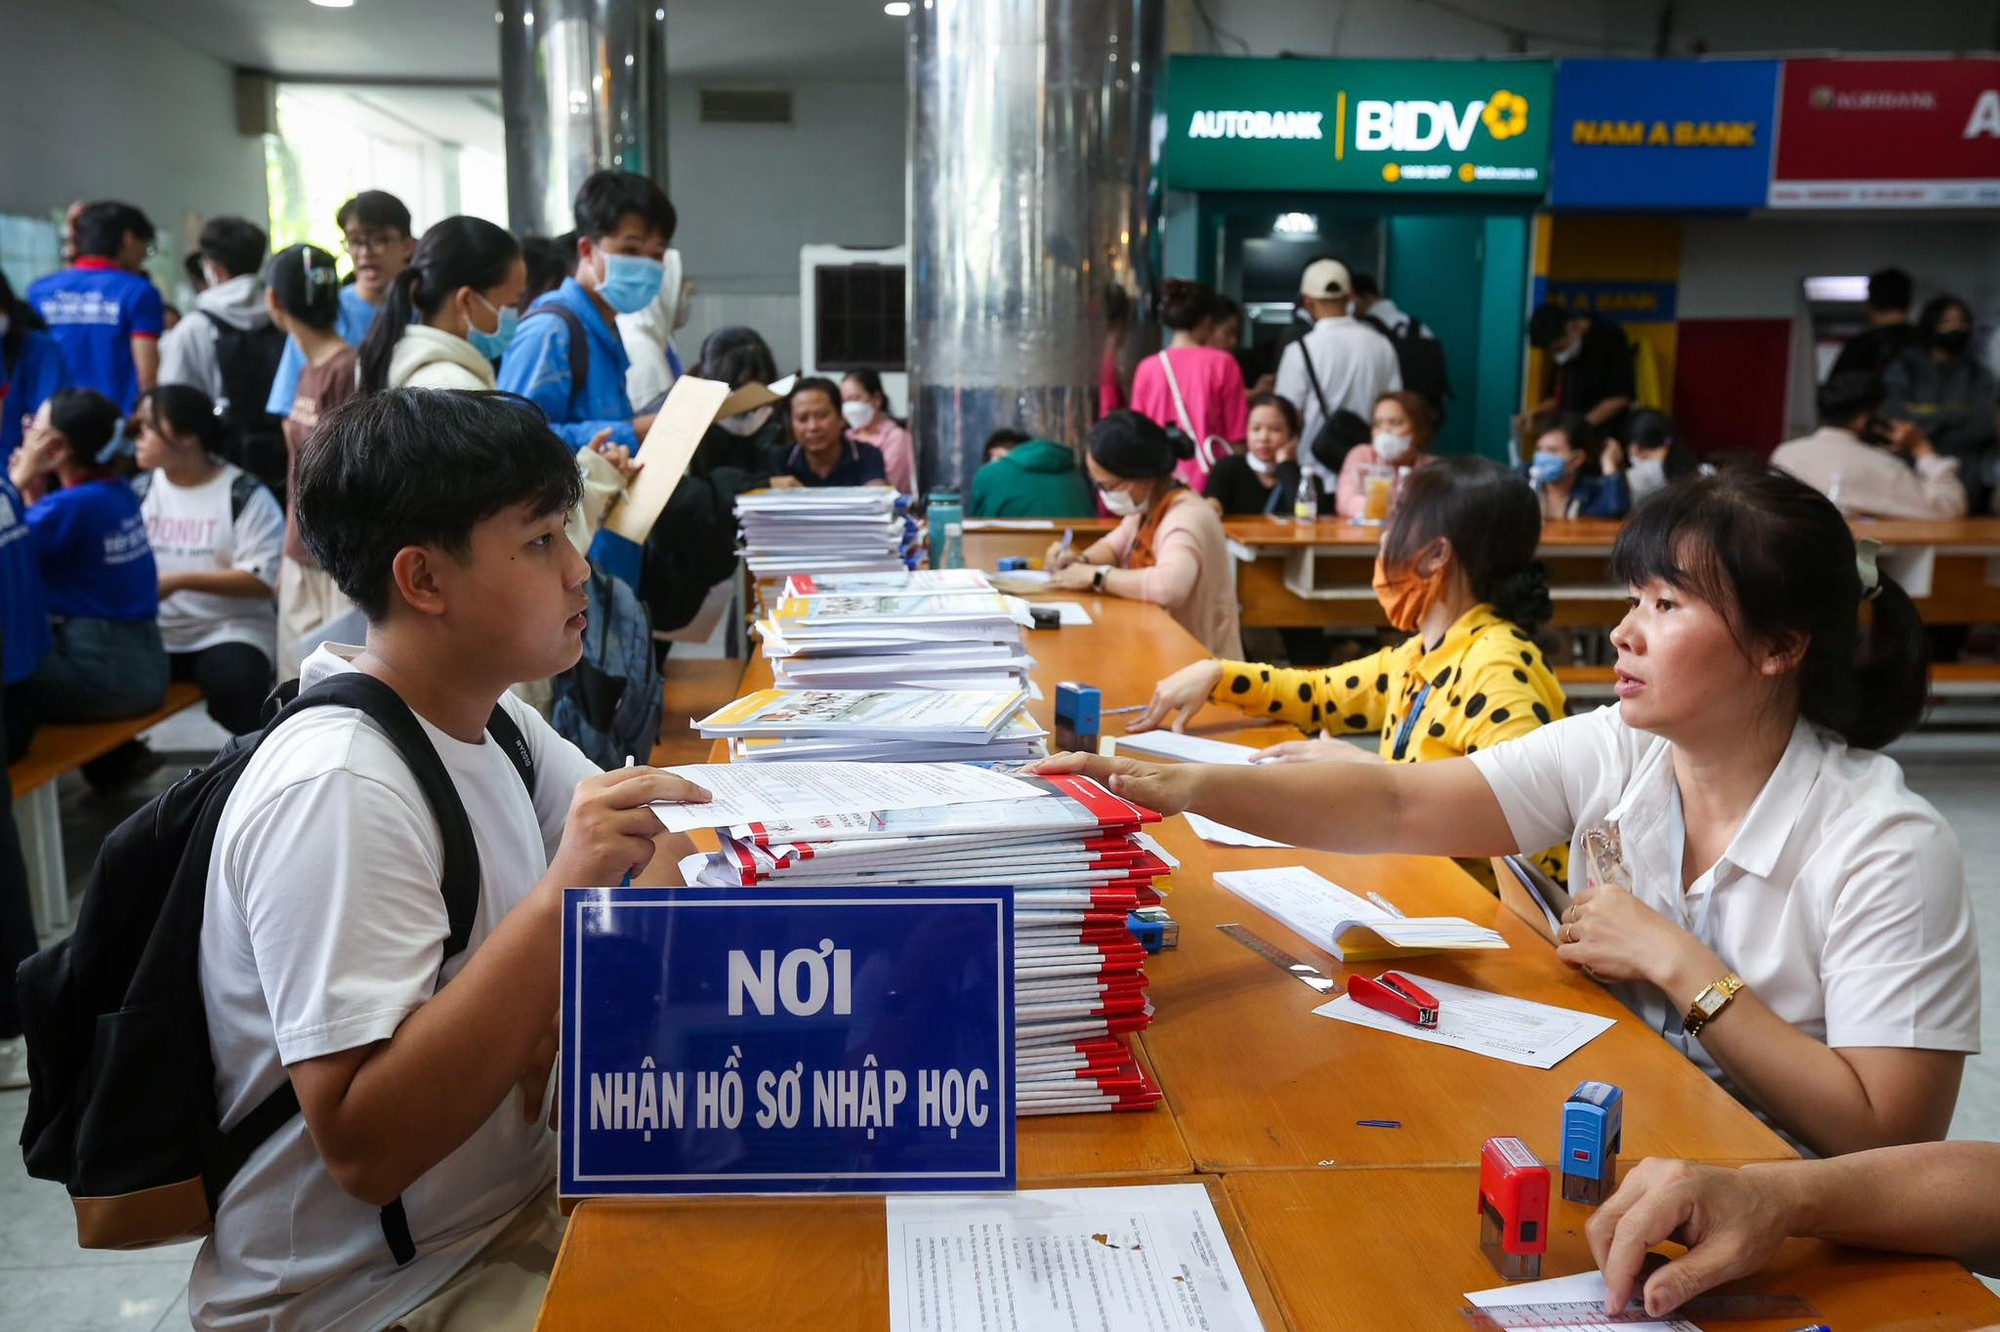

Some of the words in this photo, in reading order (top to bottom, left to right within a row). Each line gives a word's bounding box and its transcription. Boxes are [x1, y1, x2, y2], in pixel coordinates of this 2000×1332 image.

[1189, 110, 1323, 139] AUTOBANK
[1356, 101, 1485, 151] BIDV
[1572, 121, 1645, 145] NAM
[1648, 121, 1670, 146] A
[1673, 122, 1756, 147] BANK
[728, 938, 852, 1017] NƠI
[590, 1056, 684, 1141] NHẬN
[697, 1045, 744, 1129] HỒ
[756, 1061, 804, 1129] SƠ
[813, 1054, 907, 1140] NHẬP
[918, 1068, 989, 1139] HỌC
